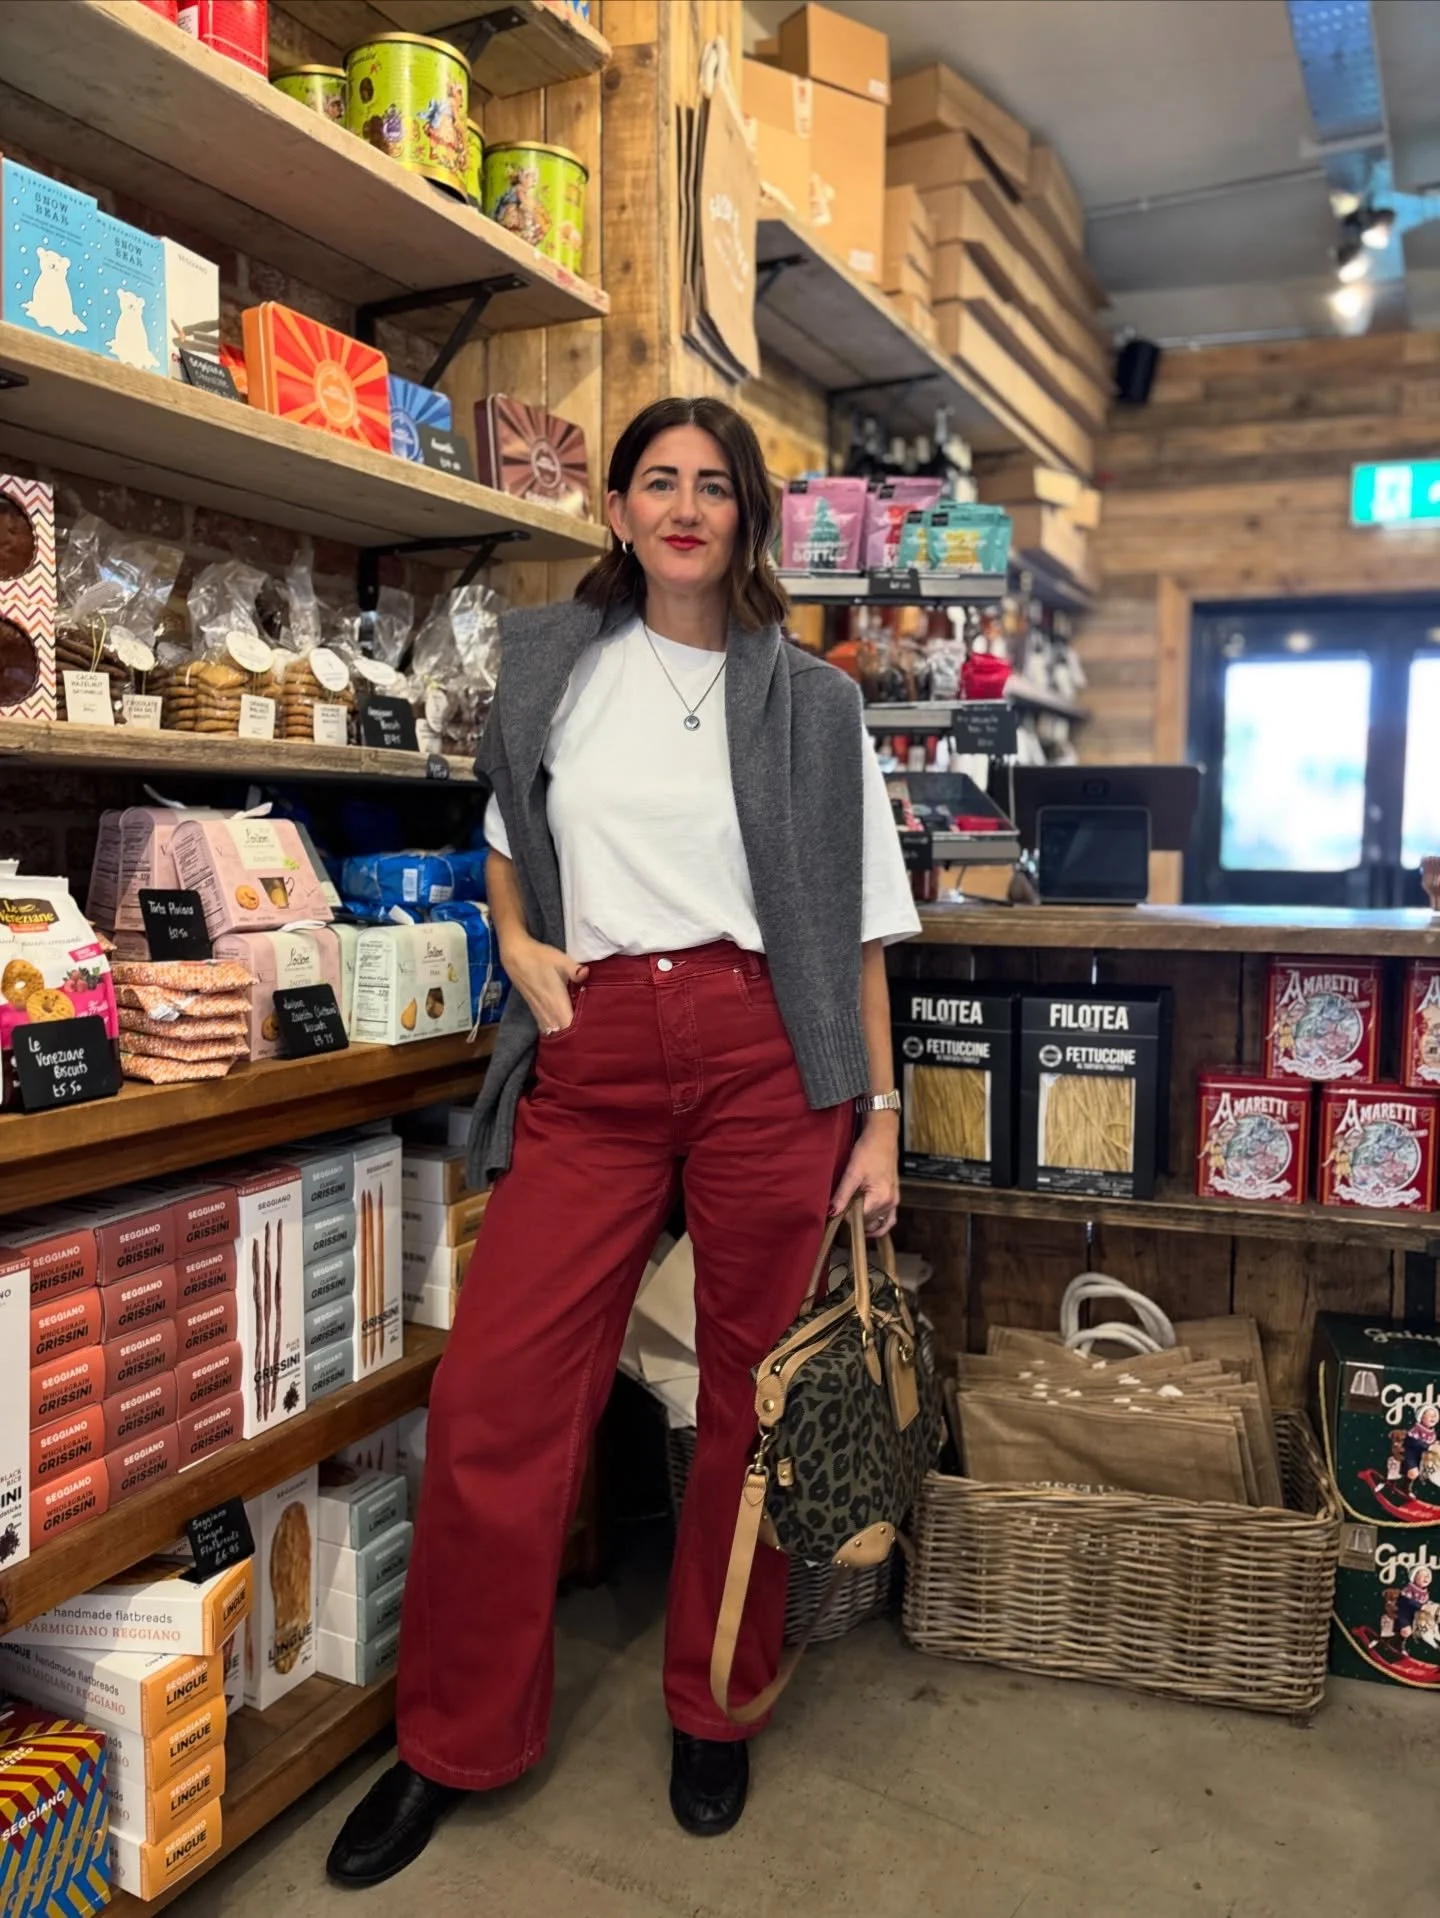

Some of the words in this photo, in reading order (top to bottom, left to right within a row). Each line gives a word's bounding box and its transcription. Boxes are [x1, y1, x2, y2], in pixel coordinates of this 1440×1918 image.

[35, 192, 68, 213] SNOW
[36, 204, 69, 225] BEAR
[115, 236, 142, 256] SNOW
[115, 248, 143, 268] BEAR
[911, 997, 984, 1025] FILOTEA
[1049, 1003, 1130, 1031] FILOTEA
[28, 1036, 41, 1053] Le
[926, 1038, 991, 1058] FETTUCCINE
[1065, 1046, 1136, 1066] FETTUCCINE
[1209, 1092, 1288, 1127] AMARETTI
[1334, 1099, 1417, 1134] AMARETTI
[312, 1166, 343, 1181] SEGGIANO
[258, 1194, 291, 1211] SEGGIANO
[311, 1183, 346, 1201] GRISSINI
[188, 1202, 225, 1220] SEGGIANO
[315, 1215, 345, 1230] SEGGIANO
[119, 1224, 160, 1243] SEGGIANO
[186, 1222, 229, 1243] GRISSINI
[313, 1232, 347, 1251] GRISSINI
[33, 1246, 80, 1267] SEGGIANO
[117, 1244, 164, 1268] GRISSINI
[186, 1254, 223, 1274] SEGGIANO
[313, 1260, 343, 1278] SEGGIANO
[30, 1267, 84, 1293] GRISSINI
[121, 1280, 162, 1302] SEGGIANO
[183, 1274, 226, 1297] GRISSINI
[311, 1278, 346, 1298] GRISSINI
[38, 1305, 85, 1328] SEGGIANO
[118, 1300, 166, 1326] GRISSINI
[187, 1305, 224, 1327] SEGGIANO
[36, 1328, 89, 1355] GRISSINI
[120, 1334, 162, 1356] SEGGIANO
[185, 1325, 227, 1350] GRISSINI
[42, 1364, 89, 1390] SEGGIANO
[117, 1353, 165, 1381] GRISSINI
[192, 1357, 230, 1380] SEGGIANO
[254, 1352, 300, 1383] GRISSINI
[312, 1368, 345, 1392] GRISSINI
[38, 1386, 92, 1415] GRISSINI
[120, 1387, 162, 1412] SEGGIANO
[190, 1376, 232, 1402] GRISSINI
[1381, 1383, 1440, 1425] Gal
[117, 1407, 165, 1436] GRISSINI
[194, 1408, 231, 1432] SEGGIANO
[40, 1421, 88, 1448] SEGGIANO
[190, 1427, 233, 1454] GRISSINI
[38, 1442, 92, 1474] GRISSINI
[124, 1440, 164, 1467] SEGGIANO
[121, 1460, 167, 1491] GRISSINI
[45, 1476, 91, 1505] SEGGIANO
[43, 1496, 96, 1531] GRISSINI
[1375, 1543, 1440, 1584] Galu
[54, 1607, 112, 1621] handmade
[116, 1610, 173, 1624] flatbreads
[223, 1590, 246, 1621] LINGUE
[25, 1623, 108, 1637] PARMIGIANO
[112, 1628, 181, 1641] REGGIANO
[0, 1642, 31, 1659] LINGUE
[35, 1653, 76, 1678] handmade
[78, 1670, 119, 1697] flatbreads
[166, 1661, 208, 1692] SEGGIANO
[76, 1688, 126, 1715] REGGIANO
[166, 1673, 208, 1706] LINGUE
[169, 1712, 212, 1745] SEGGIANO
[170, 1723, 211, 1757] LINGUE
[170, 1765, 211, 1798] SEGGIANO
[171, 1776, 211, 1811] LINGUE
[2, 1790, 65, 1841] SEGGIANO
[165, 1820, 207, 1854] SEGGIANO
[166, 1830, 207, 1866] LINGUE
